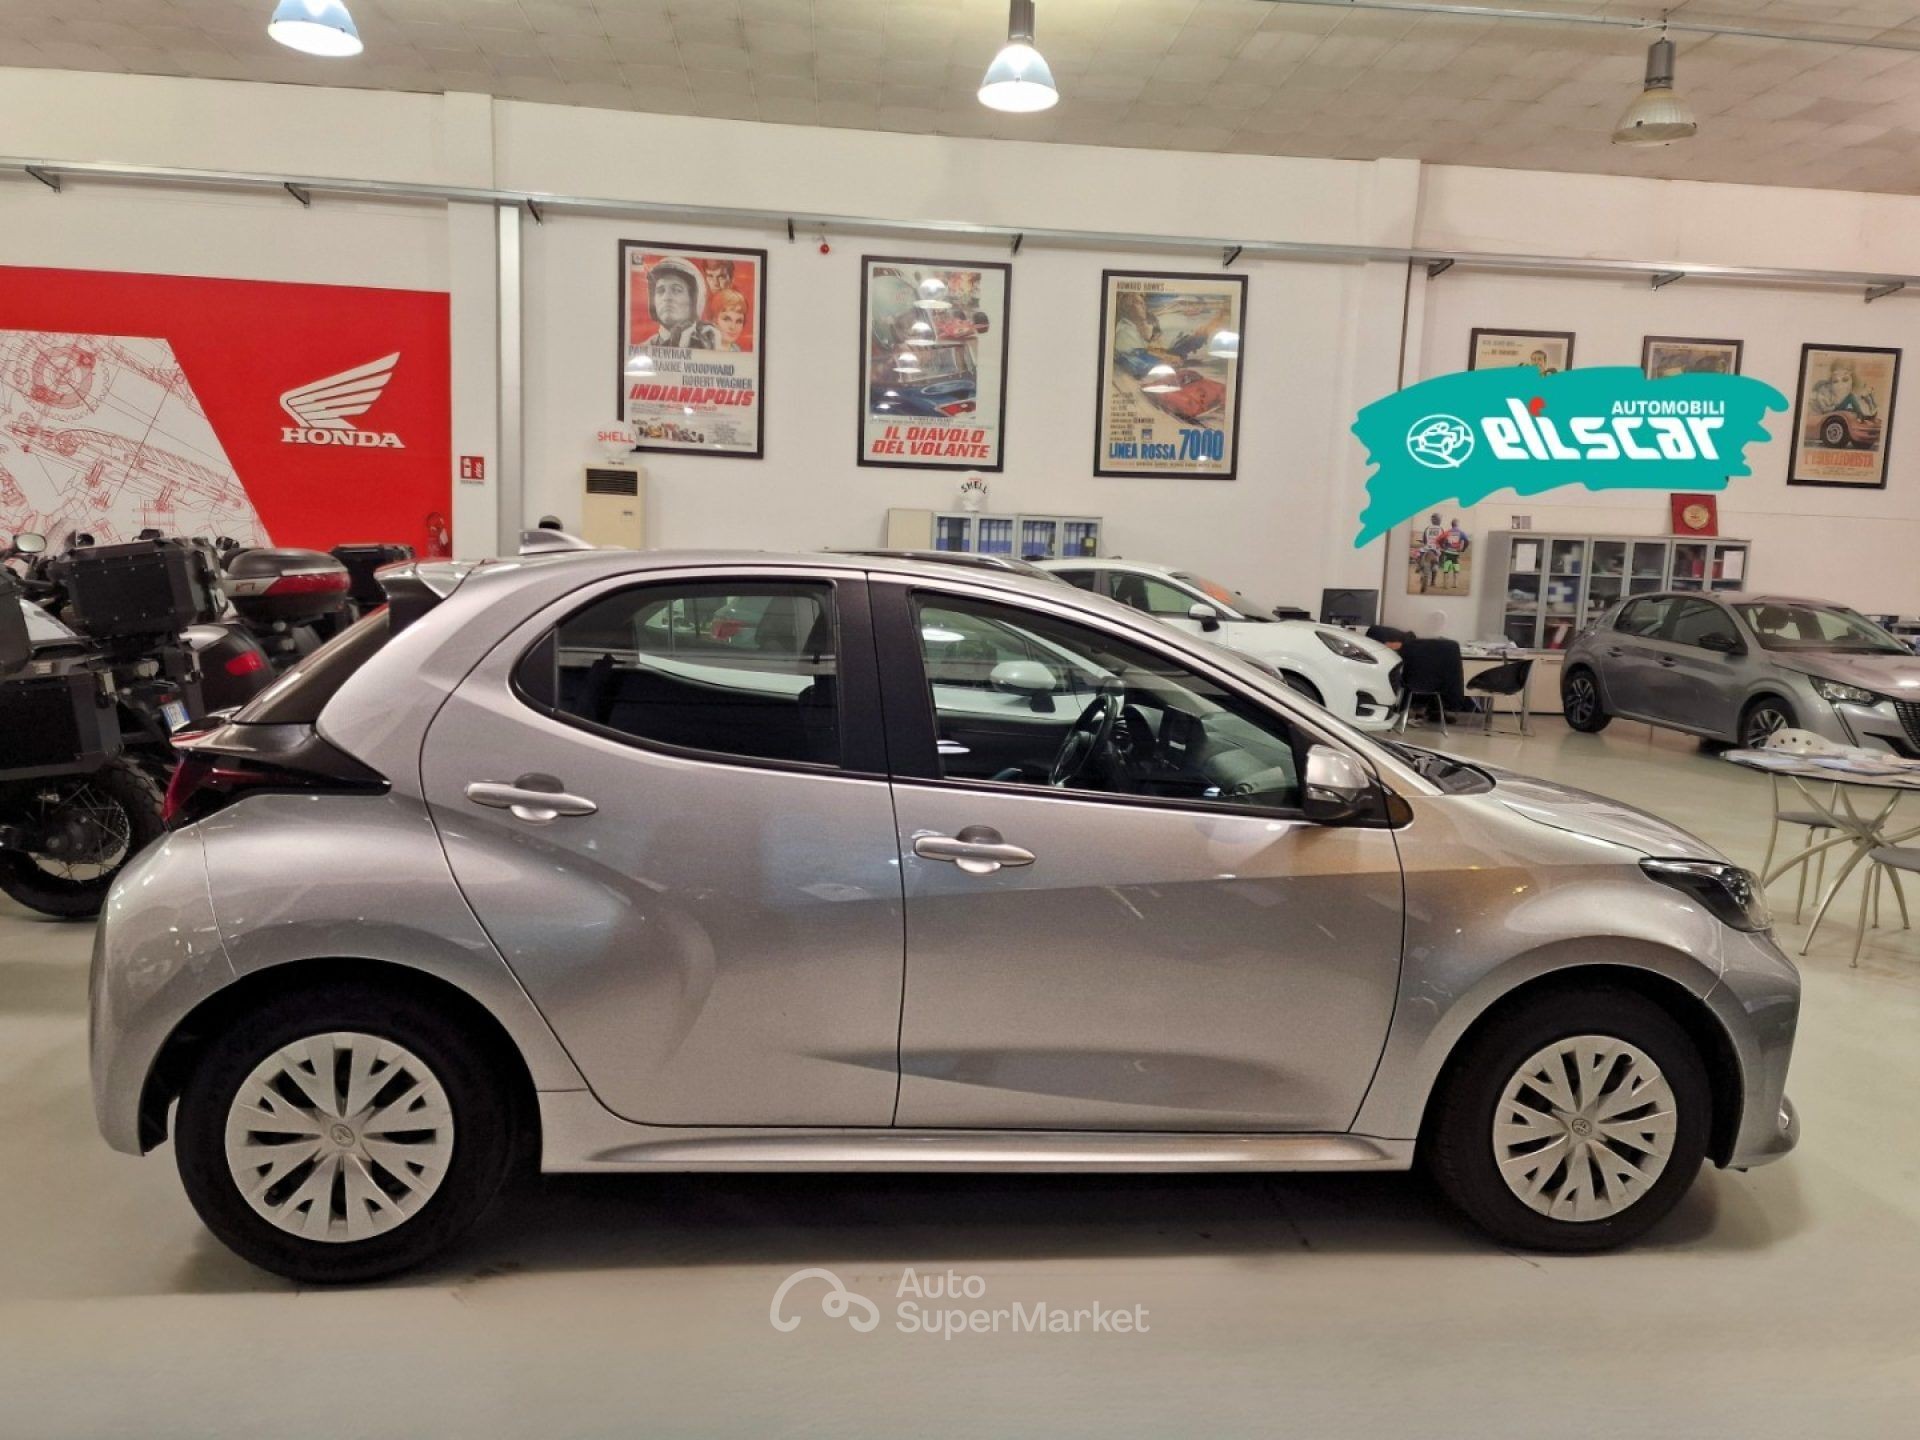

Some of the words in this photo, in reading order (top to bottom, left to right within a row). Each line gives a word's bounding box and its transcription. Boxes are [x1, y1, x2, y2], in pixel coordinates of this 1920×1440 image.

[683, 362, 734, 376] WOODWARD
[716, 376, 753, 389] WAGNER
[629, 383, 755, 406] INDIANAPOLIS
[281, 427, 406, 448] HONDA
[597, 431, 635, 444] SHELL
[884, 426, 901, 439] IL
[906, 426, 985, 443] DIAVOLO
[871, 439, 905, 454] DEL
[910, 441, 991, 458] VOLANTE
[1109, 442, 1138, 459] LINEA
[1141, 443, 1176, 460] ROSSA
[1178, 428, 1225, 461] 7000
[960, 480, 988, 494] SHELL
